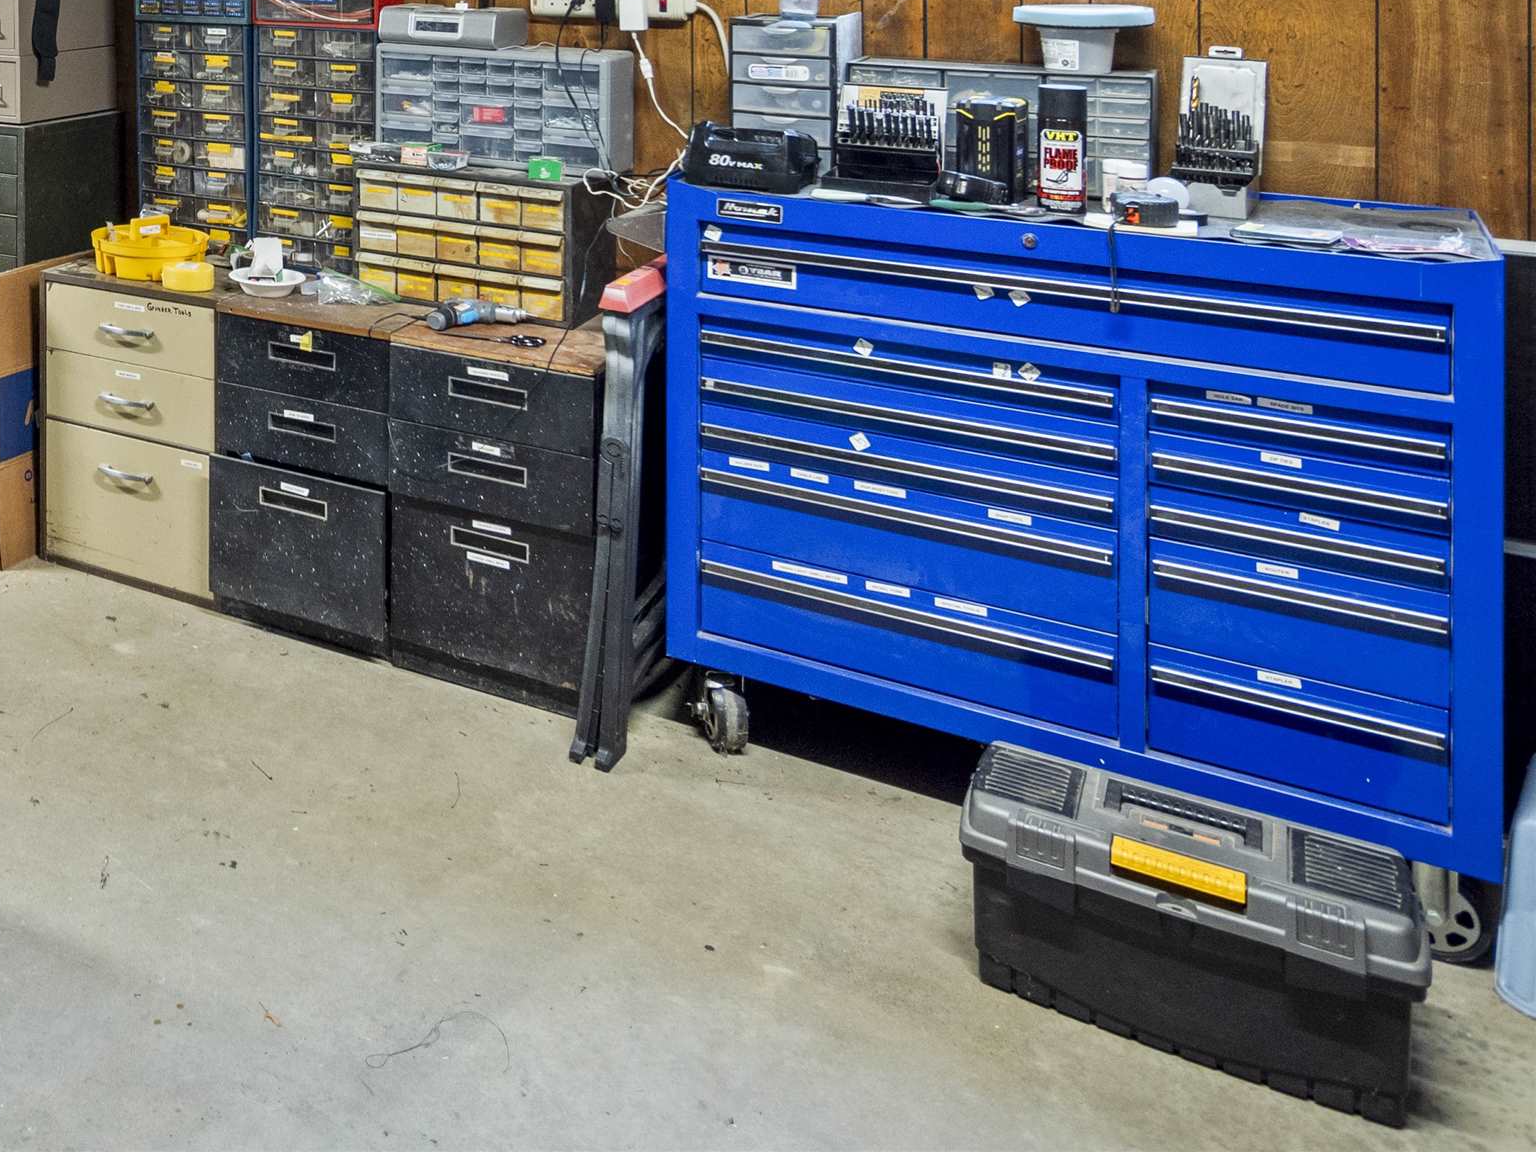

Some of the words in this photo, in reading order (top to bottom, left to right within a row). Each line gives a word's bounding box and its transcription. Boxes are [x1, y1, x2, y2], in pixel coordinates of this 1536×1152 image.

[1046, 131, 1077, 142] VHT
[1044, 147, 1078, 160] FLAME
[737, 161, 764, 170] MAX
[1044, 159, 1078, 173] PROOF
